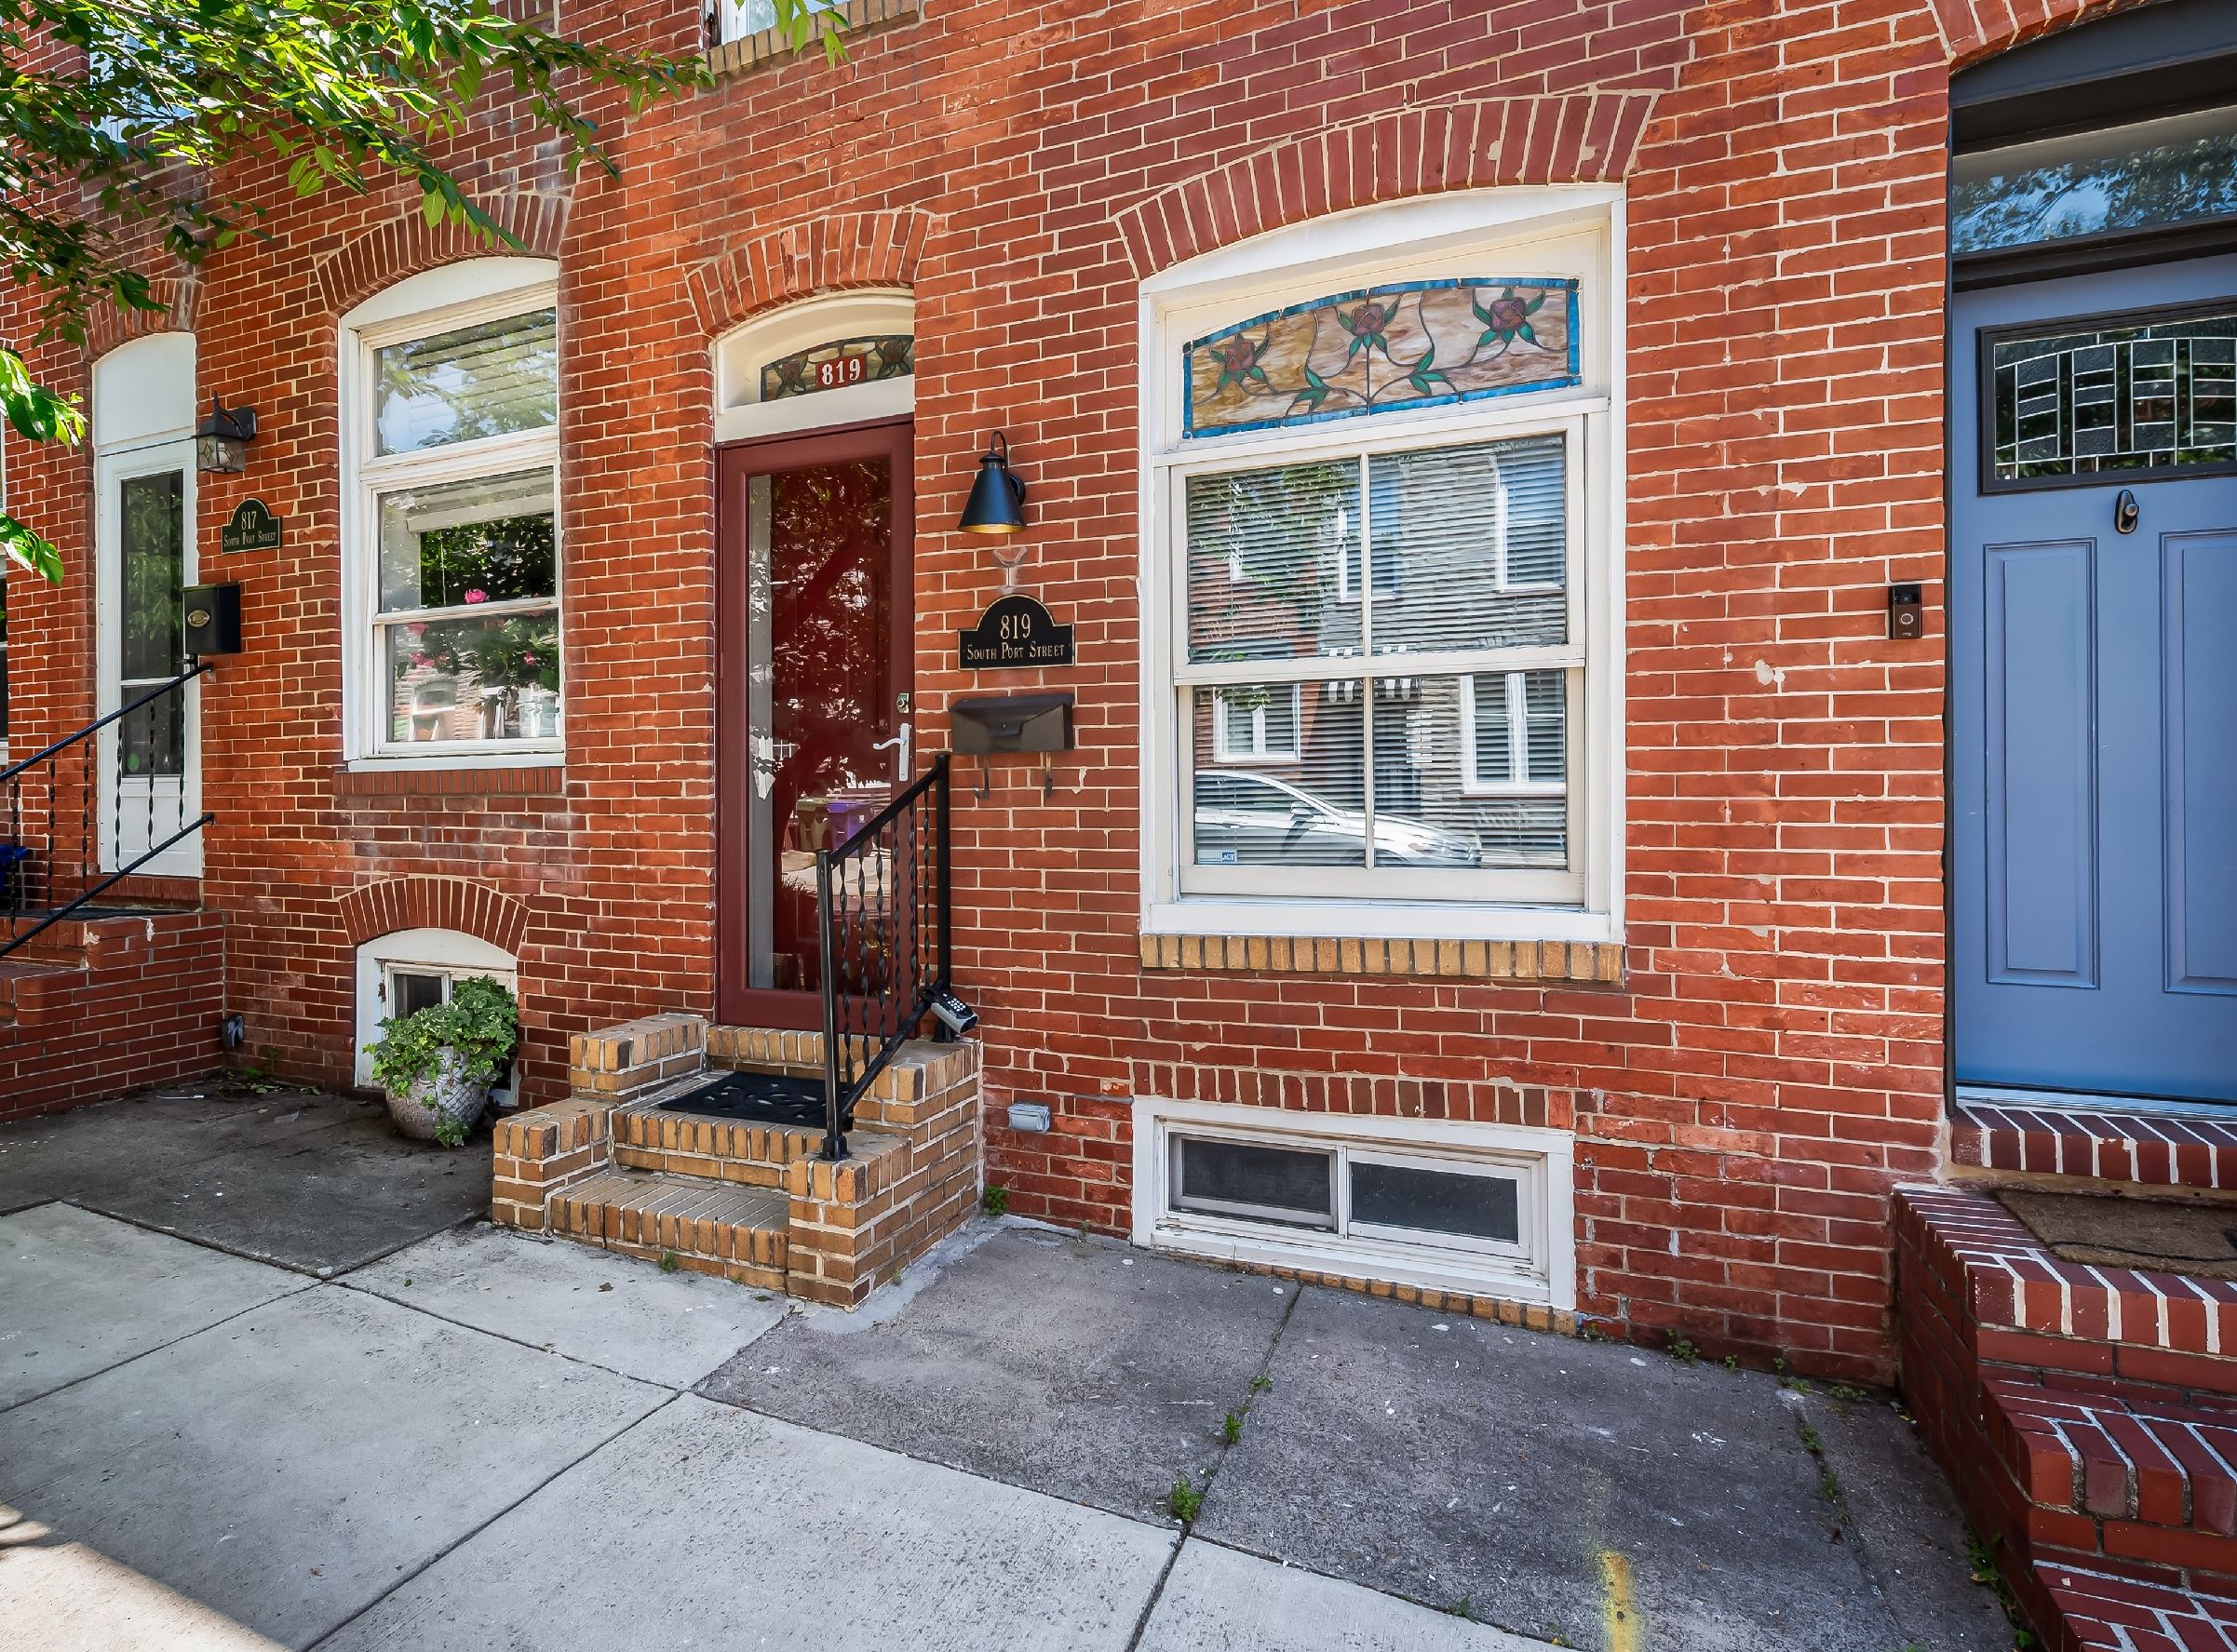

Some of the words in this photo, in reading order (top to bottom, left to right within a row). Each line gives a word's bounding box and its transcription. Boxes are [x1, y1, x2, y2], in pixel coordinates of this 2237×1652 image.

[822, 359, 861, 385] 819
[241, 511, 257, 531] 817
[1000, 613, 1031, 639] 819
